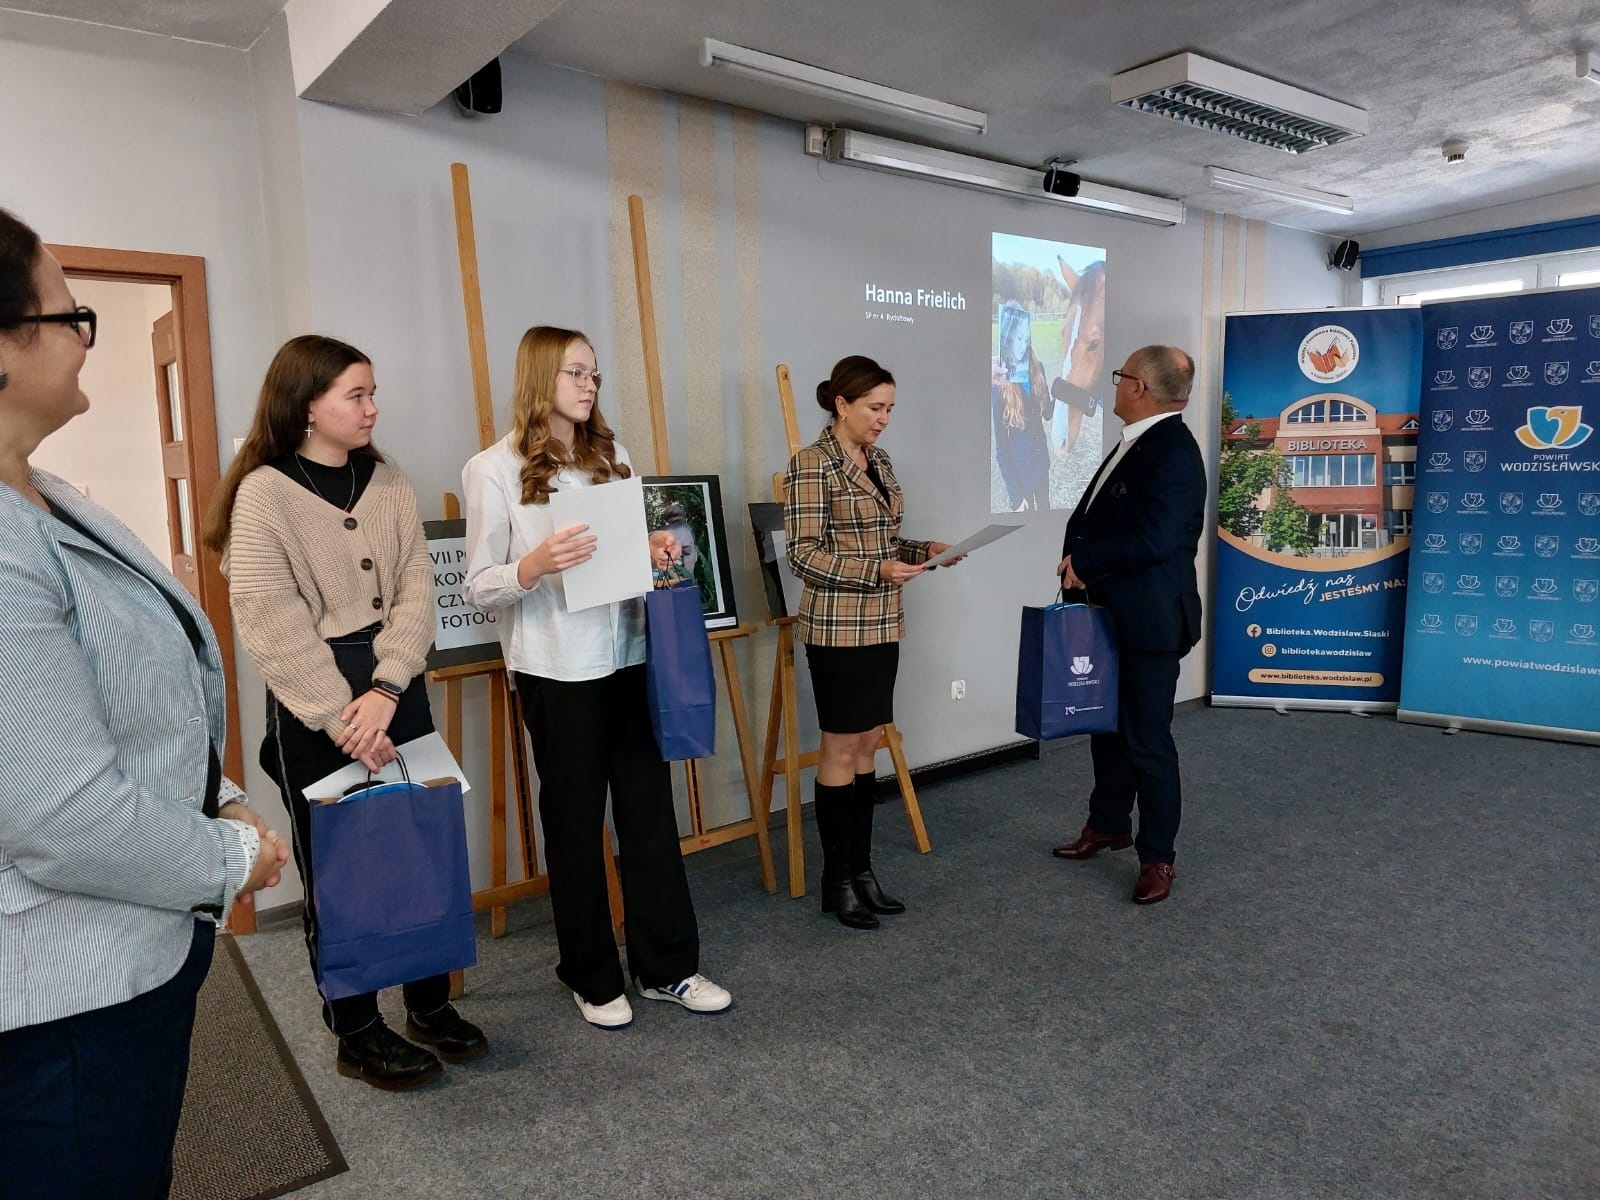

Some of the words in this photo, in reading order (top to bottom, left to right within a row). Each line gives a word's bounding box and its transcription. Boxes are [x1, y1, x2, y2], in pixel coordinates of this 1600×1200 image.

[865, 283, 913, 305] Hanna
[917, 288, 966, 310] Frielich
[1287, 439, 1367, 451] BIBLIOTEKA
[1533, 453, 1570, 461] POWIAT
[456, 550, 467, 563] P
[1235, 578, 1319, 612] Odwiedź
[1325, 574, 1356, 587] nas
[1319, 584, 1380, 602] JESTEŚMY
[1383, 578, 1406, 590] NA:
[1281, 647, 1372, 657] bibliotekawodzislaw
[1260, 672, 1373, 683] www.biblioteka.wodzislaw.pl
